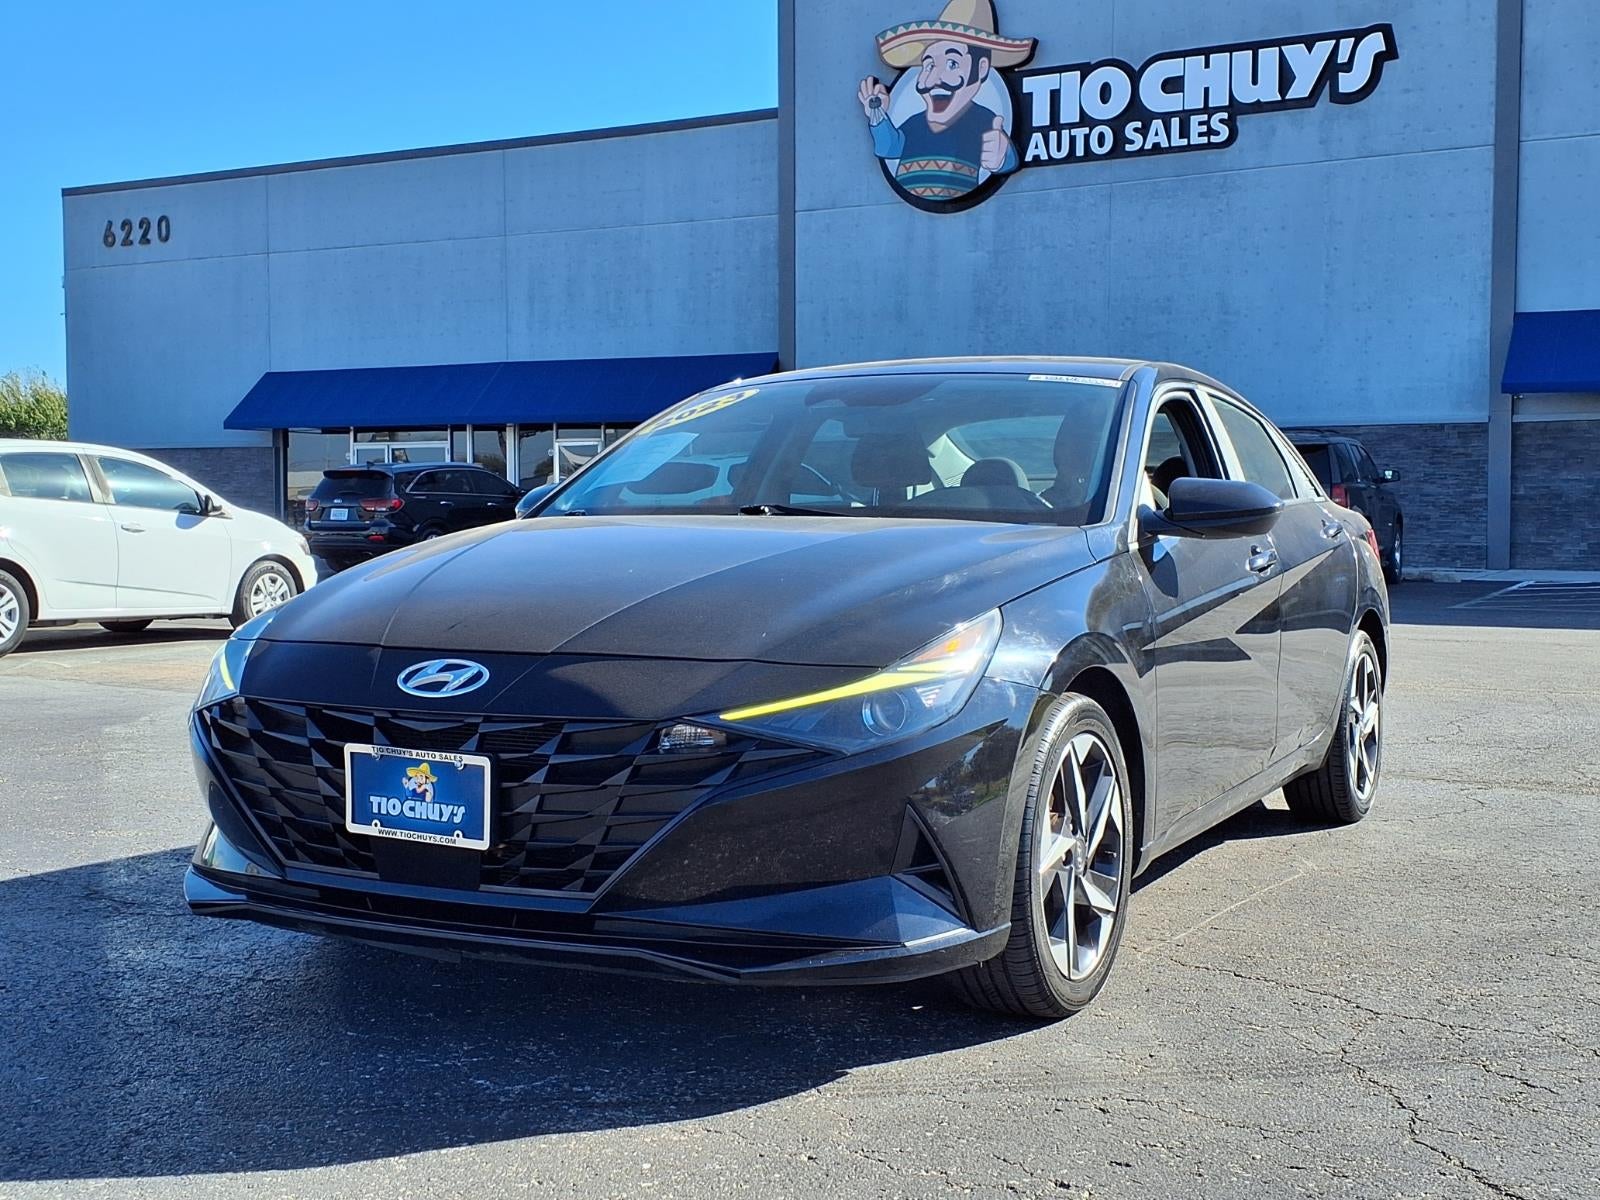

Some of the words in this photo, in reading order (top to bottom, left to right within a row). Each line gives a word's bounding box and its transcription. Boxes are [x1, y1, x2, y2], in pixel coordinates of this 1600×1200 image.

[1022, 66, 1132, 128] TIO
[1138, 31, 1387, 113] CHUY'S
[1025, 124, 1114, 162] AUTO
[1125, 112, 1229, 151] SALES
[103, 214, 171, 248] 6220
[372, 746, 384, 754] TIO
[385, 747, 414, 757] CHUY'S
[415, 751, 437, 760] AUTO
[438, 753, 464, 762] SALES
[369, 795, 402, 816] TIO
[402, 800, 466, 824] CHUY'S
[377, 828, 457, 846] WWW.TIOCHUYS.COM
